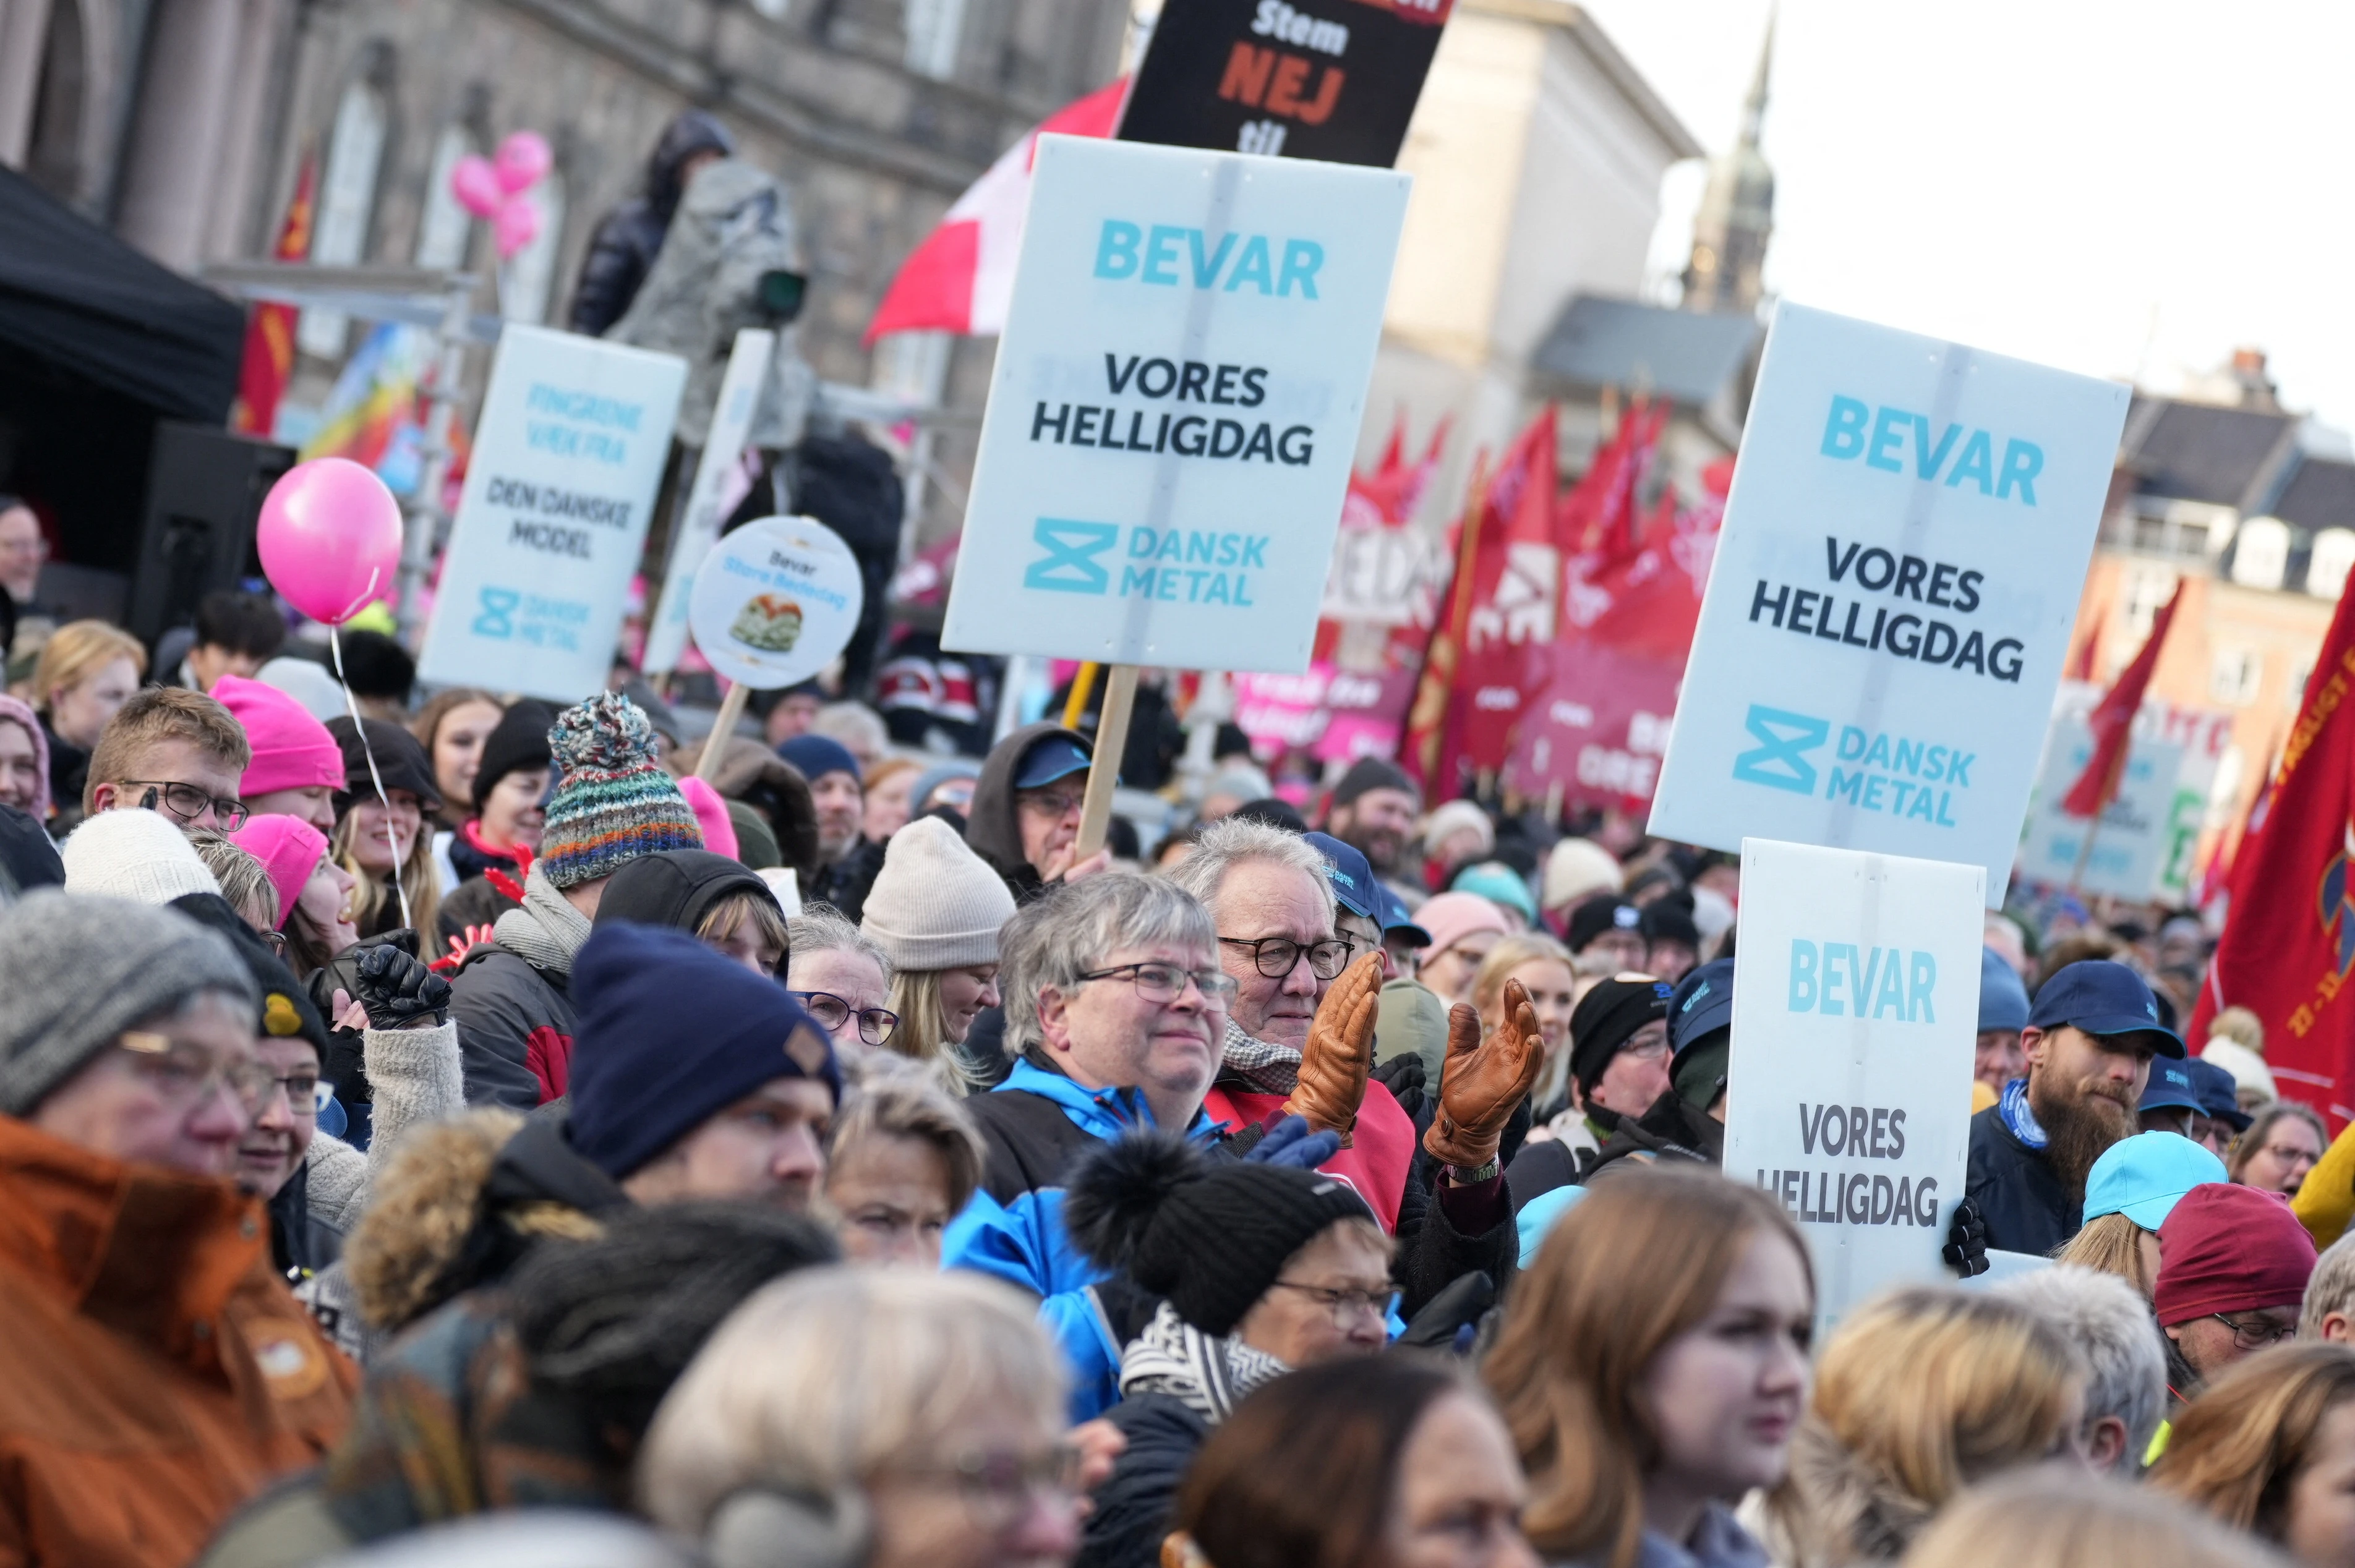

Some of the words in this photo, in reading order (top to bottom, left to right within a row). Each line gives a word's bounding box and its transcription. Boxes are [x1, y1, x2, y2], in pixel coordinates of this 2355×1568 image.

[1250, 0, 1349, 56] Stem
[1218, 41, 1345, 125] NEJ
[1237, 120, 1288, 156] til
[1093, 219, 1325, 300] BEVAR
[1105, 353, 1268, 407] VORES
[1030, 401, 1314, 466] HELLIGDAG
[1820, 394, 2043, 506] BEVAR
[487, 475, 536, 509] DEN
[541, 487, 632, 530] DANSKE
[508, 518, 591, 560] MODEL
[769, 550, 817, 576] Bevar
[1127, 526, 1270, 568] DANSK
[723, 555, 771, 583] Store
[1119, 565, 1254, 607] METAL
[1826, 536, 1984, 613] VORES
[1749, 580, 2025, 683] HELLIGDAG
[1836, 726, 1976, 788] DANSK
[1826, 767, 1956, 828] METAL
[1335, 870, 1354, 886] DANSK
[1335, 875, 1354, 890] METAL
[1788, 939, 1936, 1024] BEVAR
[1799, 1103, 1907, 1161] VORES
